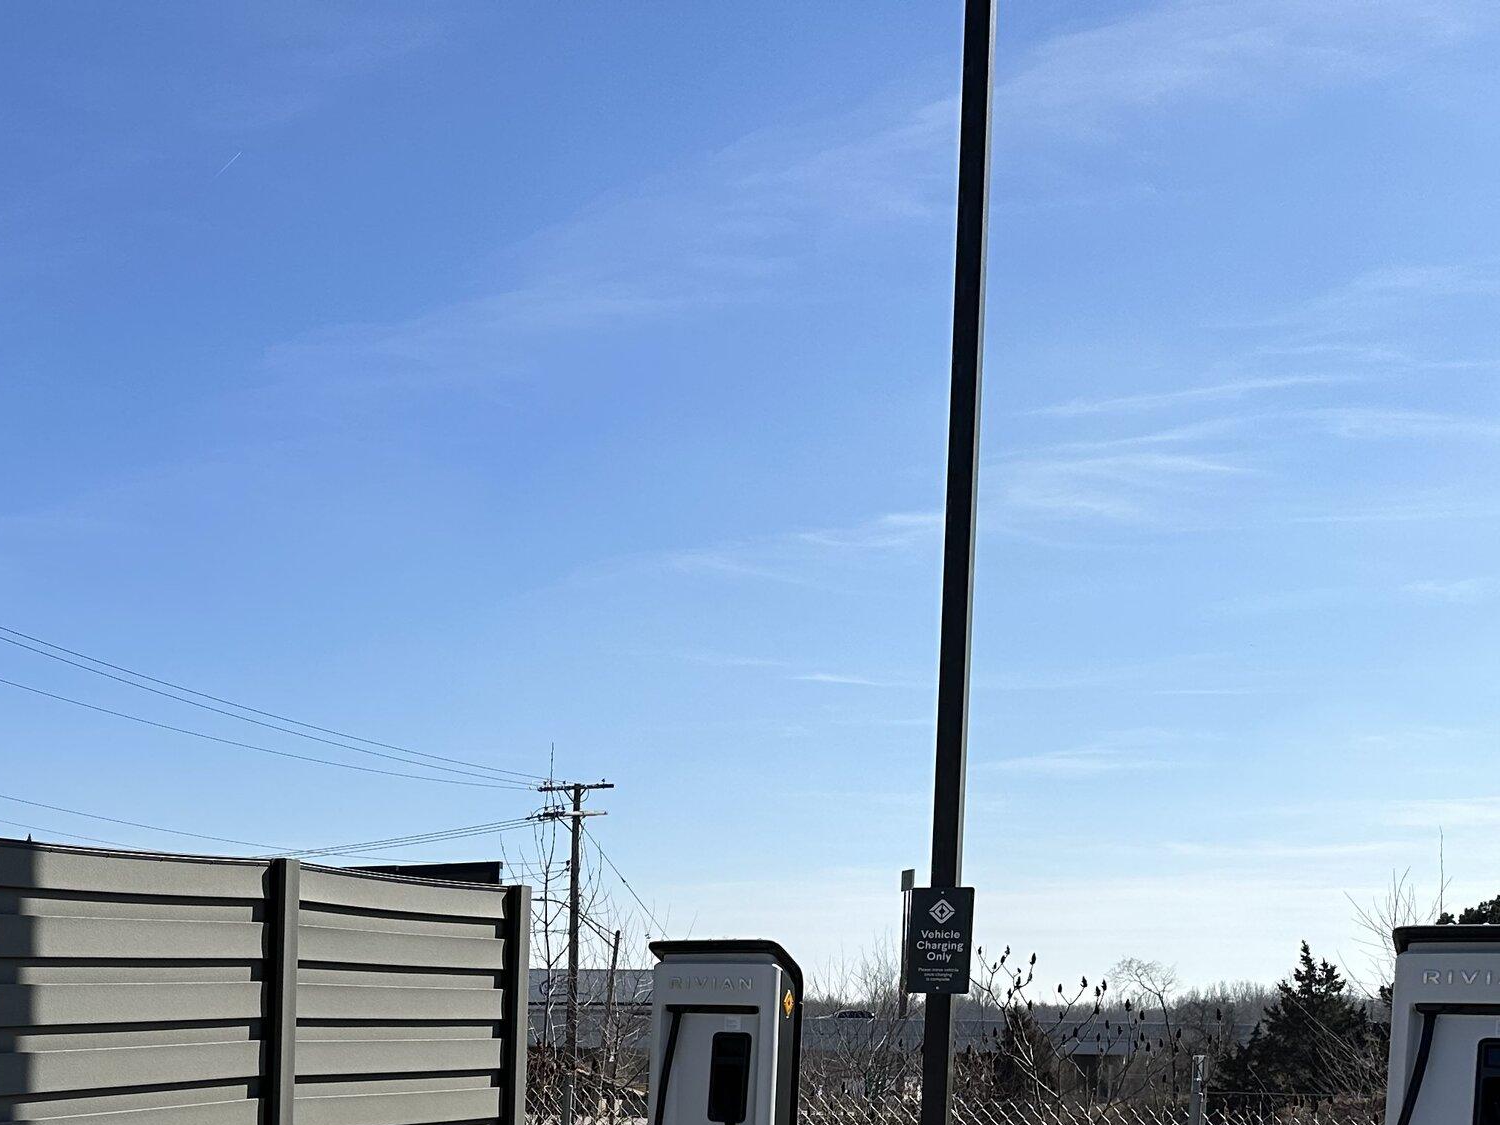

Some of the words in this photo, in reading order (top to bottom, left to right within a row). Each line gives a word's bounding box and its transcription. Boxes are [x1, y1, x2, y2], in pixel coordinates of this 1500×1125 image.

[920, 929, 961, 939] Vehicle
[916, 940, 964, 952] Charging
[926, 951, 952, 963] Only
[1422, 969, 1500, 985] RIVI
[668, 976, 755, 991] RIVIAN
